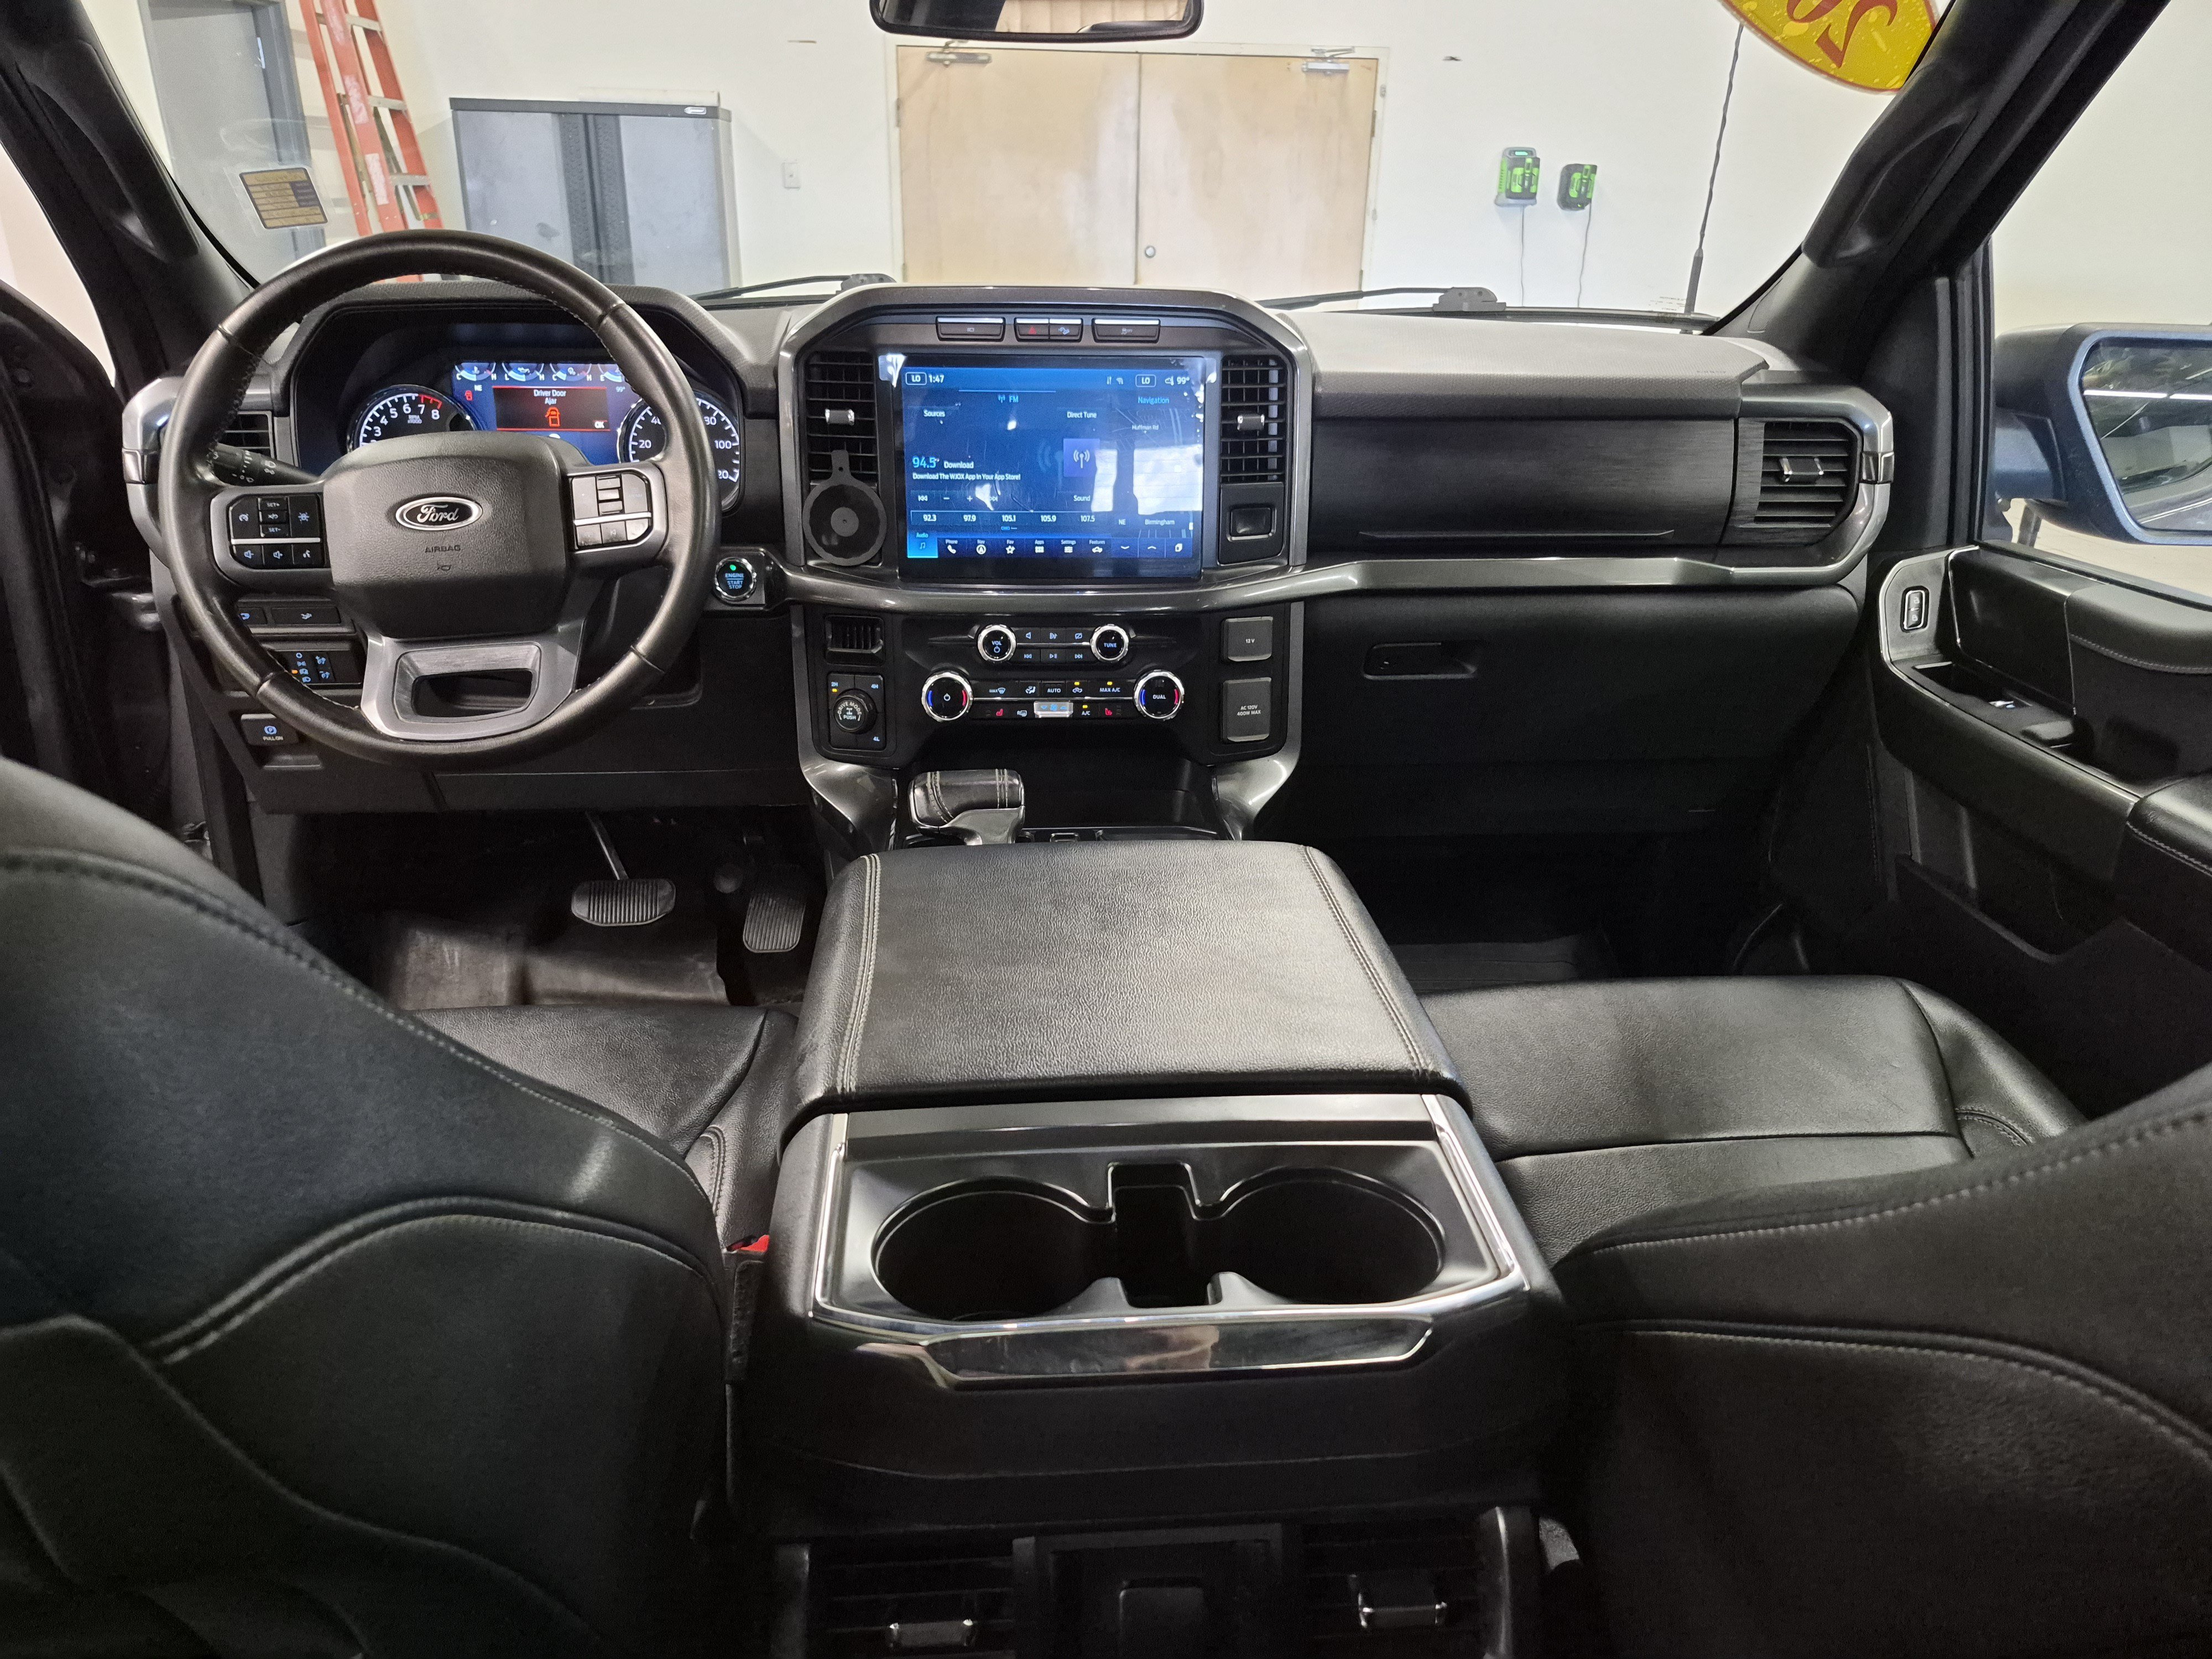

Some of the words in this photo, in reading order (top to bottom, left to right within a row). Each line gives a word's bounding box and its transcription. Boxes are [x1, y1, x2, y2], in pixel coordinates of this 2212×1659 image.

[929, 374, 945, 383] 1:47
[1138, 397, 1169, 405] Navigation
[390, 408, 398, 418] 5
[403, 404, 411, 414] 6
[418, 404, 425, 414] 7
[924, 409, 945, 417] Sources
[431, 409, 440, 420] 8
[380, 415, 388, 425] 4
[373, 426, 382, 436] 3
[639, 440, 651, 448] 20
[714, 440, 732, 449] 100
[912, 456, 936, 468] 94.5
[943, 461, 974, 469] Download
[416, 504, 460, 523] Ford
[425, 545, 461, 553] AIRBAG
[837, 701, 849, 714] DRIVE
[849, 701, 862, 715] MODE
